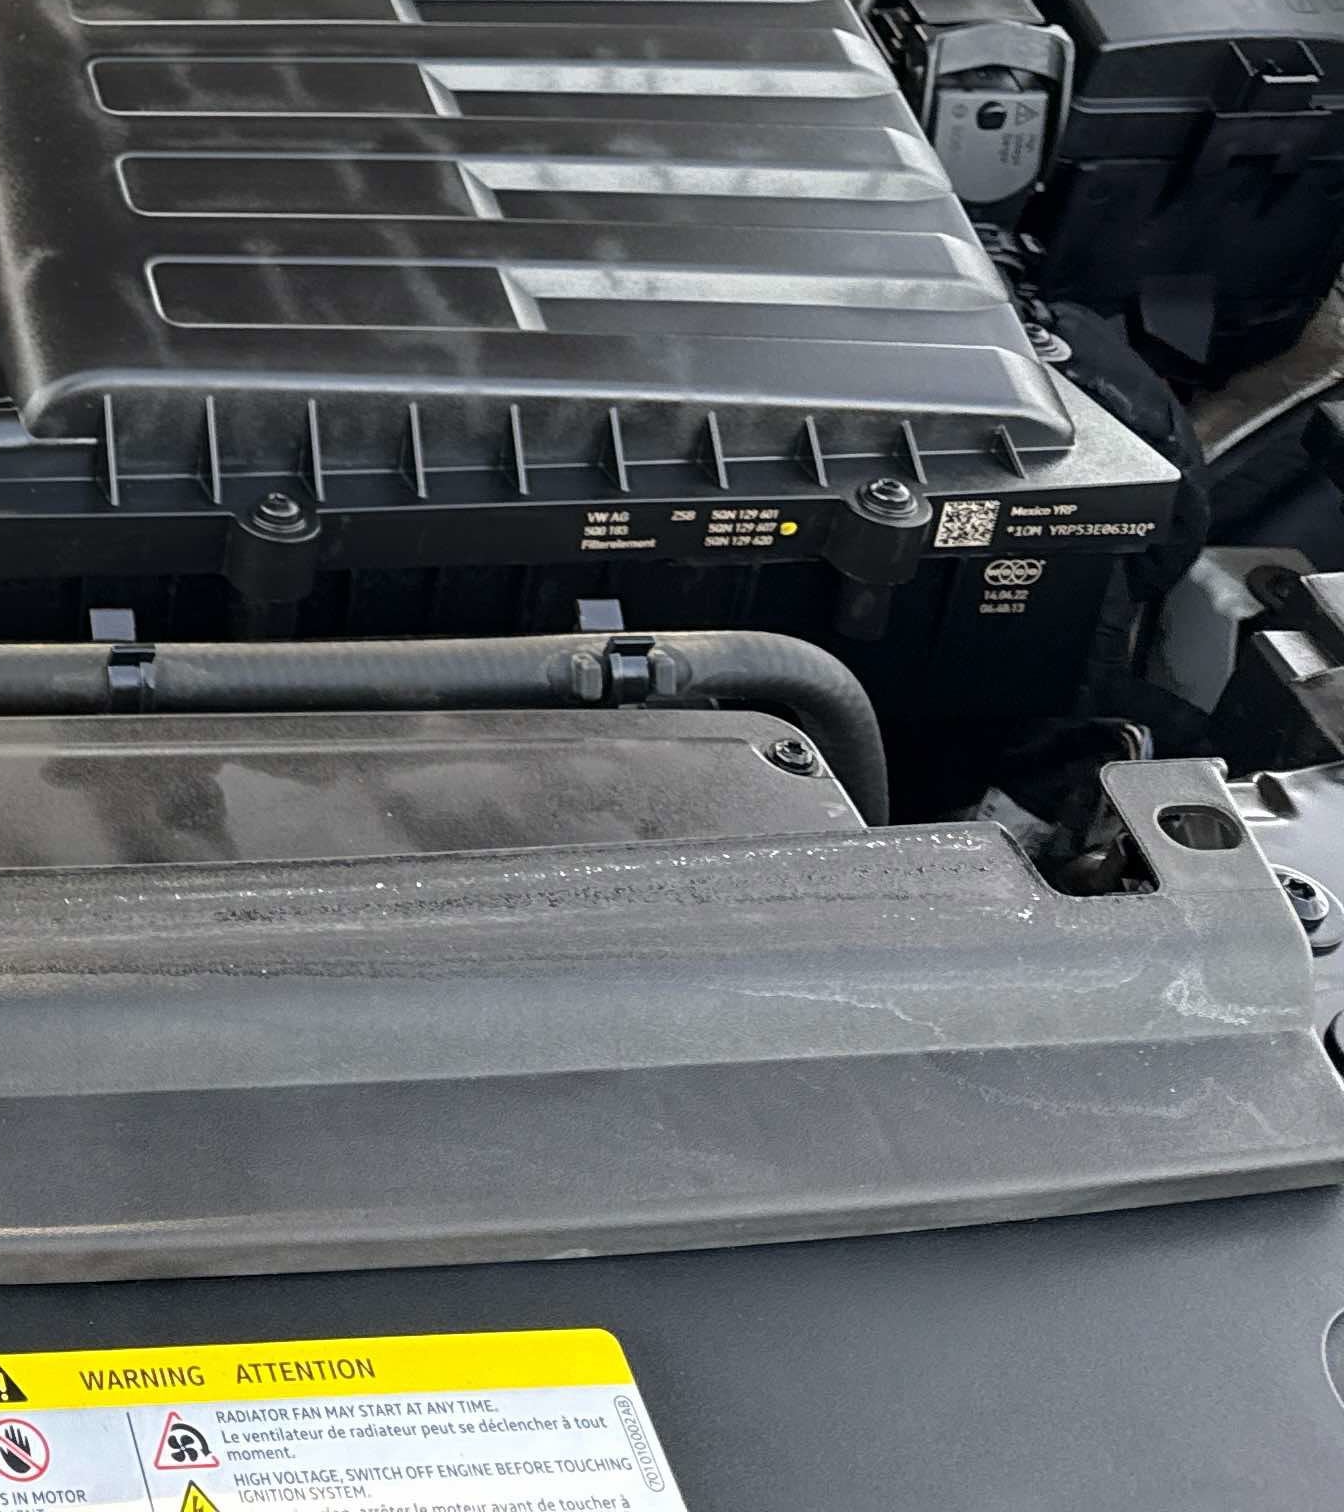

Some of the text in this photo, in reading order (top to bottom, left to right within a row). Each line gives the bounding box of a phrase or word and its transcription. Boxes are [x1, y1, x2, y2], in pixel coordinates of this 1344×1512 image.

[587, 511, 630, 523] VW AG
[739, 509, 758, 520] 129
[1010, 504, 1078, 517] Mexico YRP
[735, 523, 755, 533] 129
[731, 536, 751, 546] 129
[79, 1358, 376, 1391] WARNING ATTENTION
[216, 1399, 499, 1424] RADIATOR FAN MAY START AT ANY TIME.
[221, 1416, 608, 1444] Le ventilateur de radiateur peut se déclencher à tout
[227, 1447, 296, 1461] moment.
[233, 1457, 633, 1487] HIGH VOLTAGE, SWITCH OFF ENGINE BEFORE TOUCHING
[12, 1491, 29, 1506] IN
[32, 1490, 88, 1505] MOTOR
[238, 1486, 372, 1503] IGNITION SYSTEM.
[432, 1501, 488, 1512] moteur
[491, 1500, 533, 1512] avant
[537, 1497, 556, 1511] de
[558, 1495, 618, 1511] toucher
[621, 1494, 631, 1509] à
